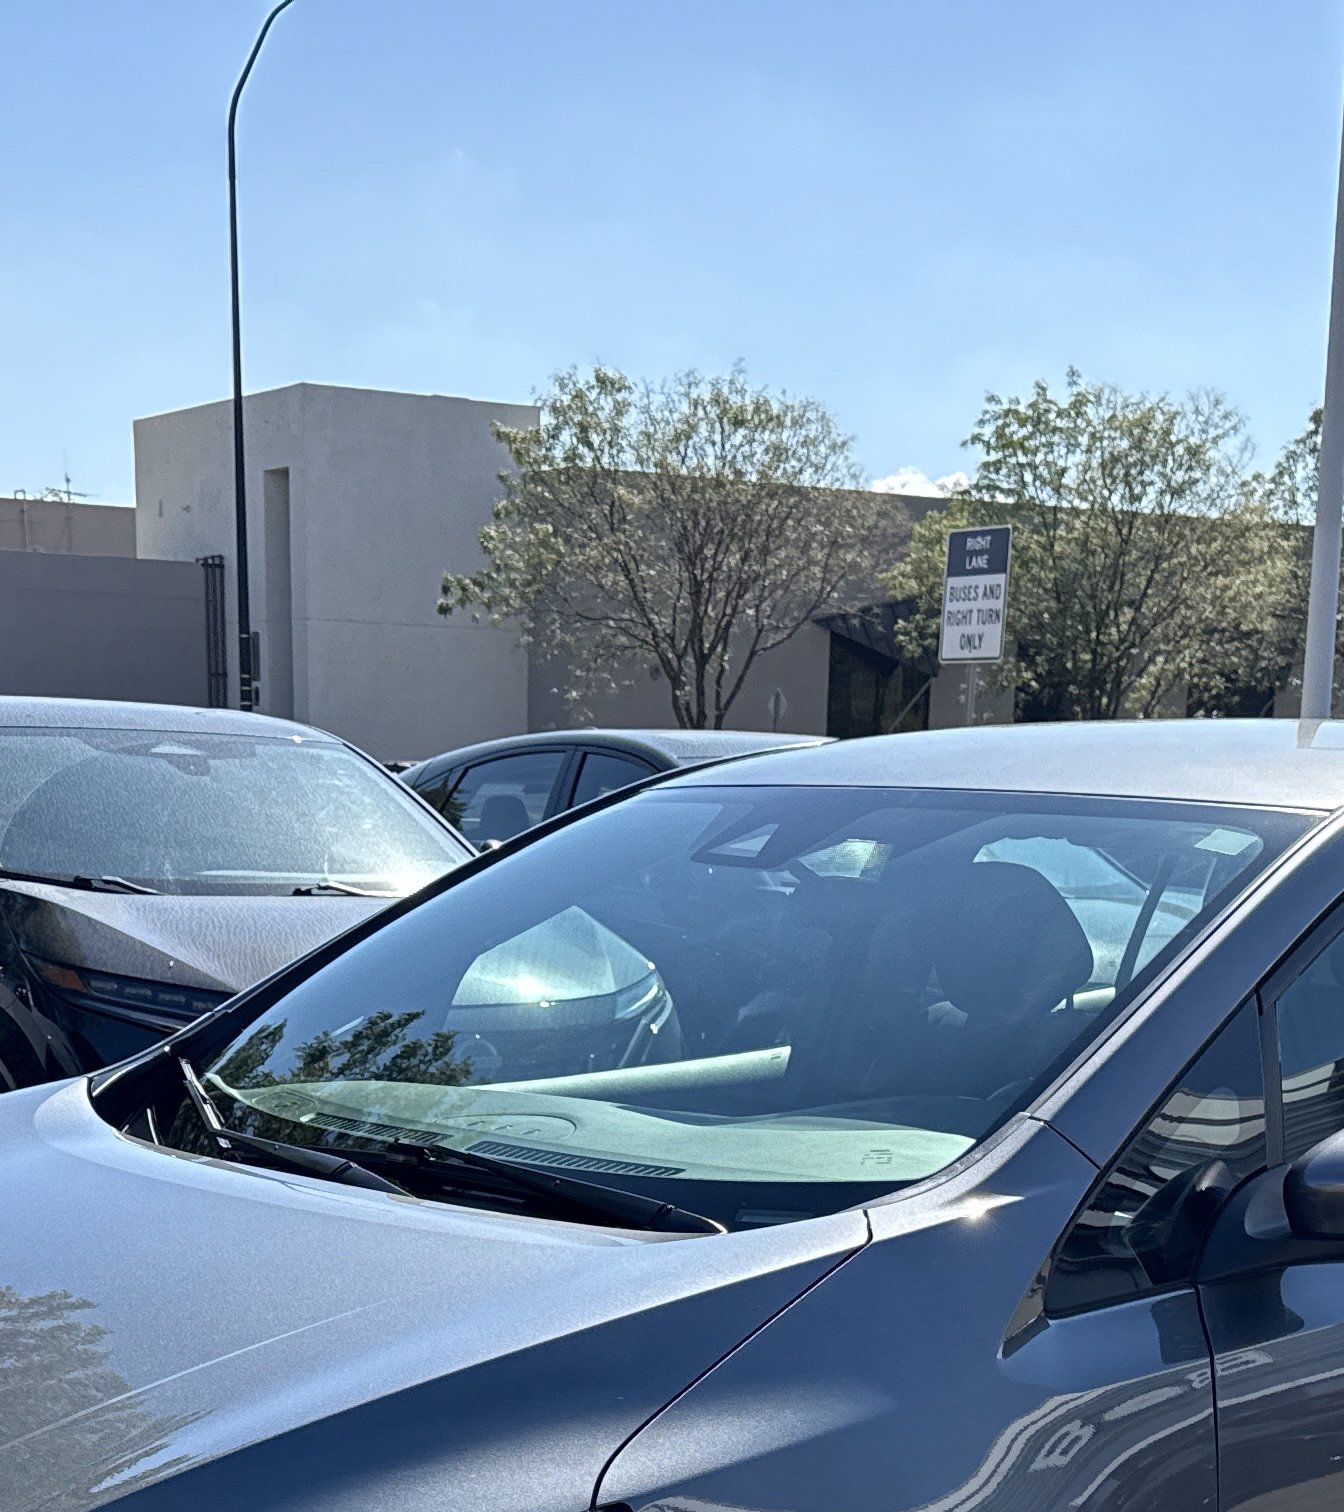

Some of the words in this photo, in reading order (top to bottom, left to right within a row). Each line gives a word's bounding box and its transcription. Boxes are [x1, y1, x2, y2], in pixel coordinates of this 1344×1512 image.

[966, 536, 991, 550] RIGHT
[966, 555, 989, 569] LANE
[949, 584, 979, 602] BUSES
[982, 583, 1002, 601] AND
[946, 609, 973, 626] RIGHT
[976, 608, 1001, 625] TURN
[959, 632, 984, 651] ONLY
